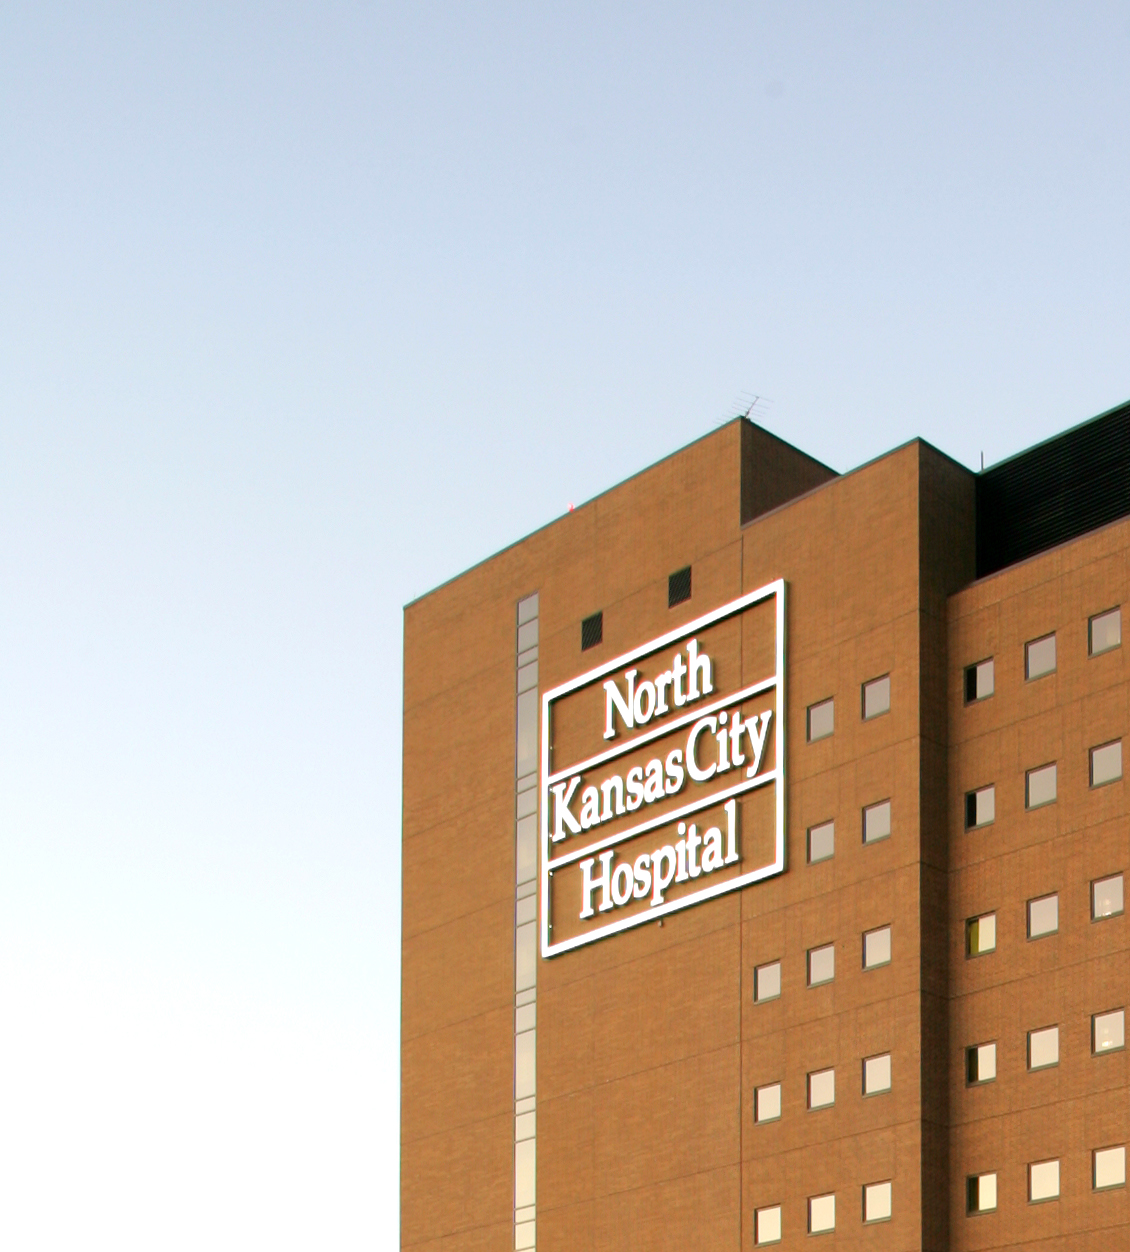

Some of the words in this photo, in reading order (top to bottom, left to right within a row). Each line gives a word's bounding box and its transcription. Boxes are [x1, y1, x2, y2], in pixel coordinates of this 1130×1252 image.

[602, 638, 714, 741] North
[551, 743, 686, 843] Kansas
[685, 709, 773, 783] City
[579, 798, 740, 920] Hospital
